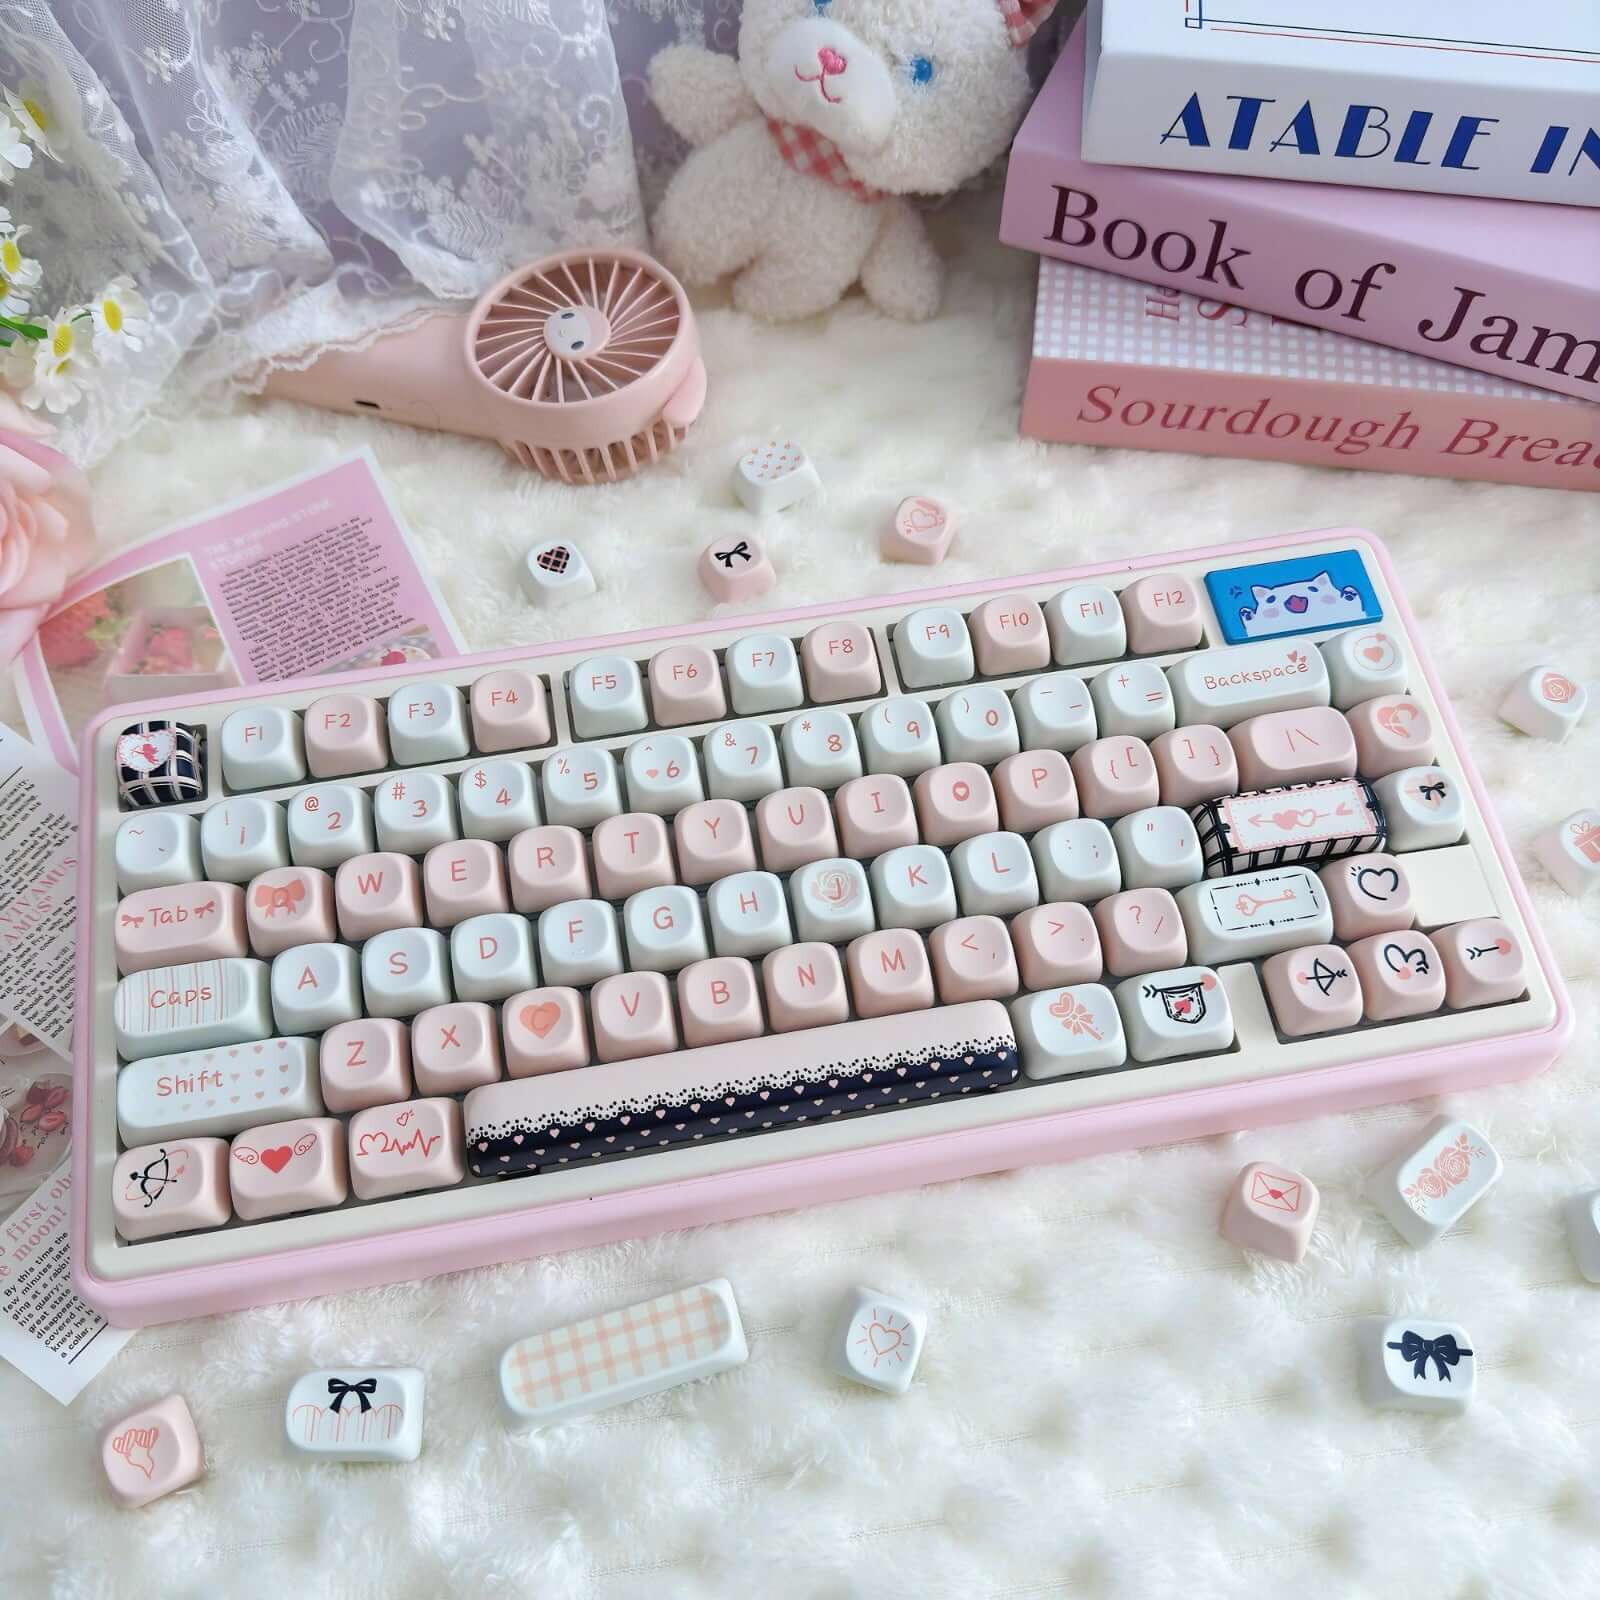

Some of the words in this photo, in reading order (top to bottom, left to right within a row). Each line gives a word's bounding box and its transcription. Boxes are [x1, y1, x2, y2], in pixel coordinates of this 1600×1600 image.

[1043, 185, 1253, 290] Book
[1294, 262, 1398, 322] of
[1417, 286, 1600, 384] Jam
[1076, 384, 1421, 455] Sourdough
[1440, 418, 1600, 468] Brea
[1080, 601, 1104, 618] F11
[1154, 591, 1185, 607] F12
[1000, 612, 1029, 629] F10
[926, 624, 950, 640] F9
[829, 639, 853, 655] F8
[752, 652, 775, 667] F7
[592, 675, 616, 690] F5
[673, 664, 698, 680] F6
[1204, 661, 1309, 690] Backspace
[492, 690, 520, 706] F4
[325, 713, 351, 729] F2
[409, 702, 435, 719] F3
[245, 727, 262, 743] F1
[907, 721, 920, 738] 9
[828, 734, 842, 752] 8
[746, 746, 758, 764] 7
[667, 760, 680, 778] 6
[1032, 768, 1048, 788] P
[584, 772, 598, 790] 5
[496, 788, 511, 806] 4
[871, 792, 885, 813] I
[413, 800, 427, 817] 3
[788, 804, 804, 826] U
[328, 812, 341, 830] 2
[704, 817, 720, 839] Y
[624, 832, 639, 854] T
[537, 847, 555, 868] R
[992, 853, 1010, 873] L
[451, 860, 467, 881] E
[908, 865, 928, 887] K
[358, 872, 383, 894] W
[829, 878, 844, 901] J
[740, 891, 758, 913] H
[149, 906, 188, 927] Tab
[653, 906, 673, 929] G
[569, 920, 583, 943] F
[480, 937, 497, 959] D
[389, 952, 408, 974] S
[881, 949, 905, 972] M
[298, 966, 318, 989] A
[798, 963, 815, 986] N
[150, 987, 212, 1009] Caps
[711, 981, 730, 1004] B
[621, 992, 640, 1017] V
[441, 1025, 460, 1049] X
[347, 1040, 366, 1066] Z
[157, 1071, 223, 1096] Shift
[6, 1200, 49, 1242] first
[4, 1285, 16, 1296] By
[18, 1267, 34, 1283] this
[35, 1247, 53, 1264] time
[55, 1233, 67, 1244] the
[22, 1264, 52, 1294] minutes
